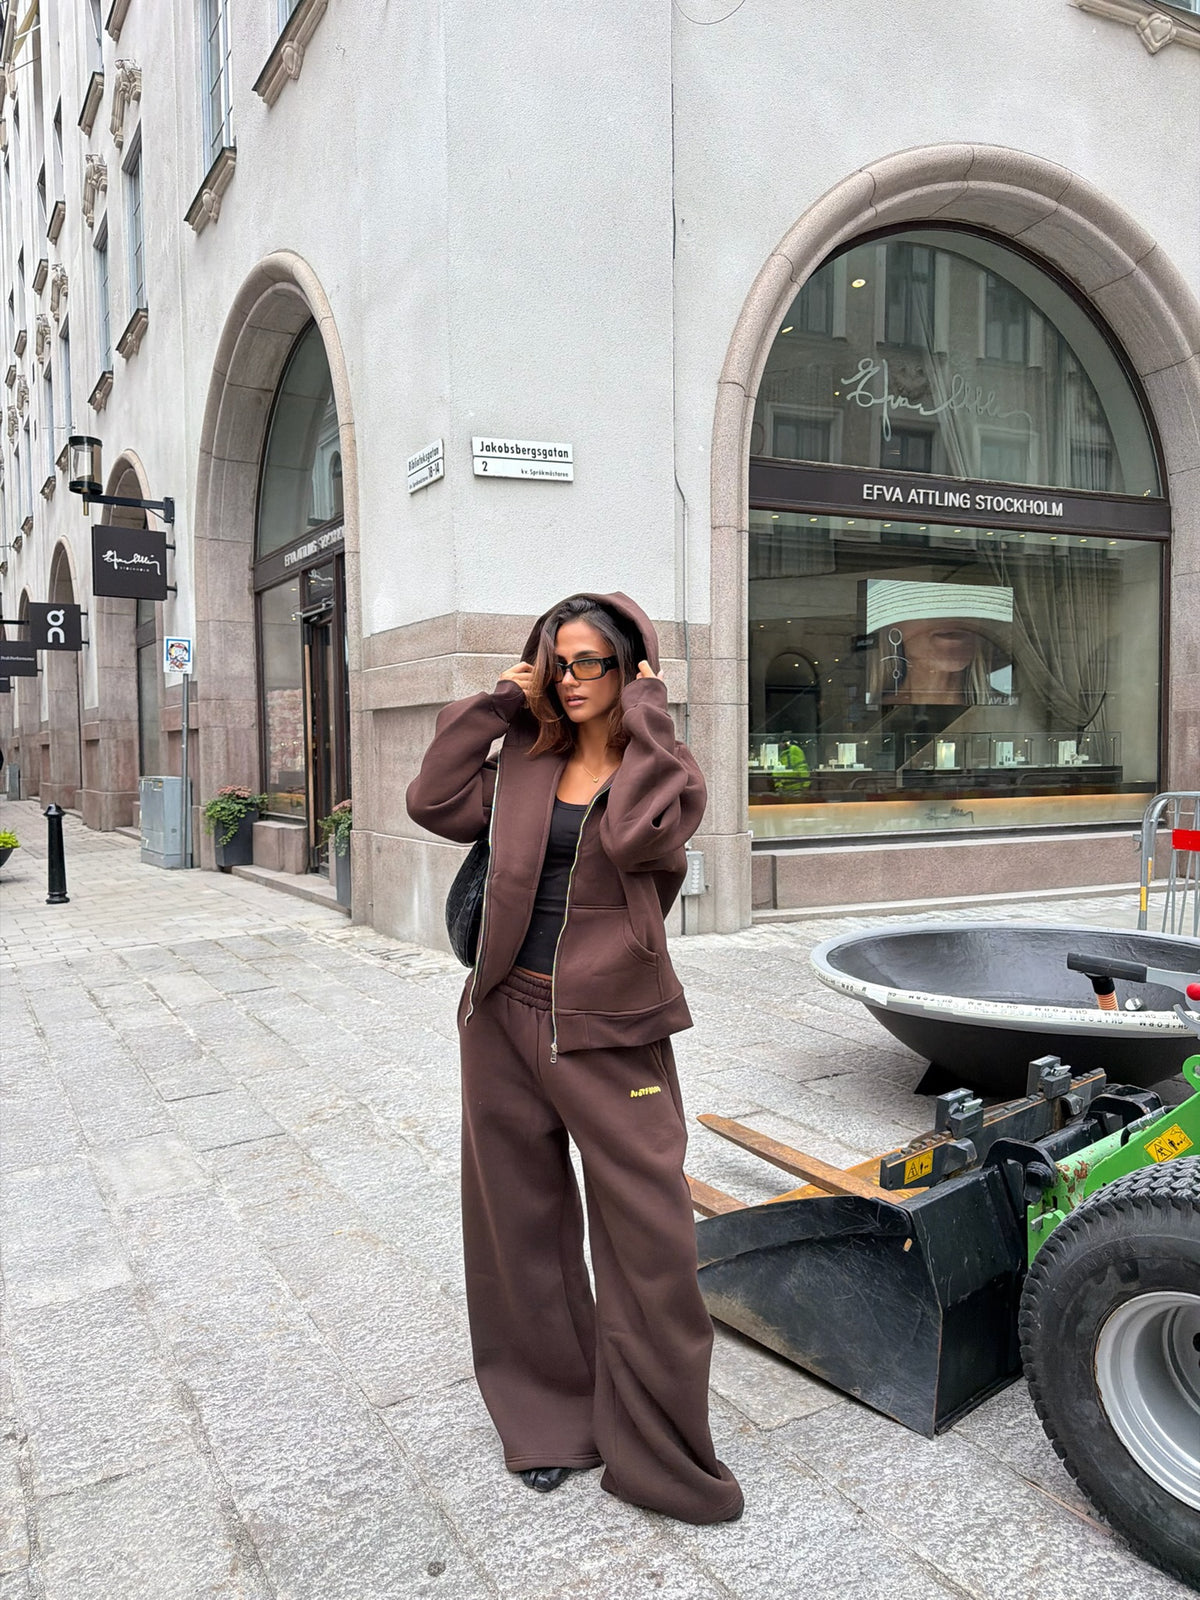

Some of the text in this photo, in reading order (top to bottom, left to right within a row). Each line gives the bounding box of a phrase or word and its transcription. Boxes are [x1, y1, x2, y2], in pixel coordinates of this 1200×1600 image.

[480, 441, 569, 459] Jakobsbergsgatan
[482, 461, 489, 472] 2
[863, 484, 1063, 517] EFVA ATTLING STOCKHOLM
